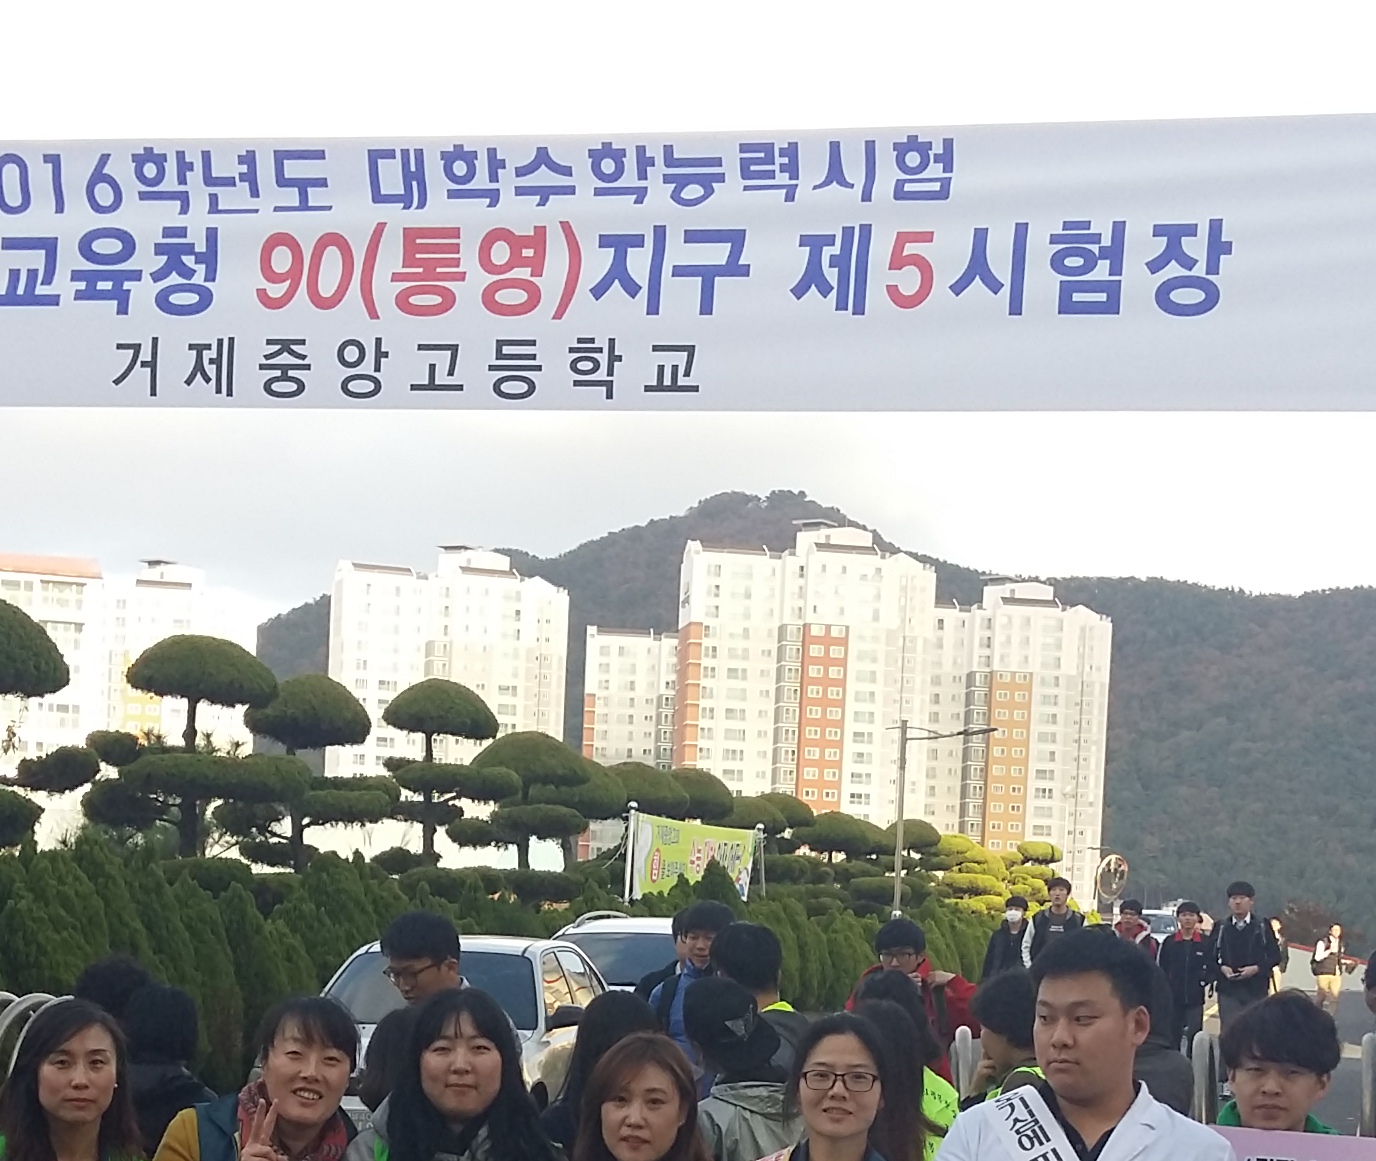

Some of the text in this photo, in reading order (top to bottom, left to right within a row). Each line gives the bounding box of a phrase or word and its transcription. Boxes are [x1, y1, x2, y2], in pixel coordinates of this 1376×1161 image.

[368, 135, 953, 210] 대학수학능력시험
[256, 221, 750, 320] 90(통영)지구
[790, 219, 1232, 316] 제5시험장
[112, 337, 699, 400] 거제중앙고등학교
